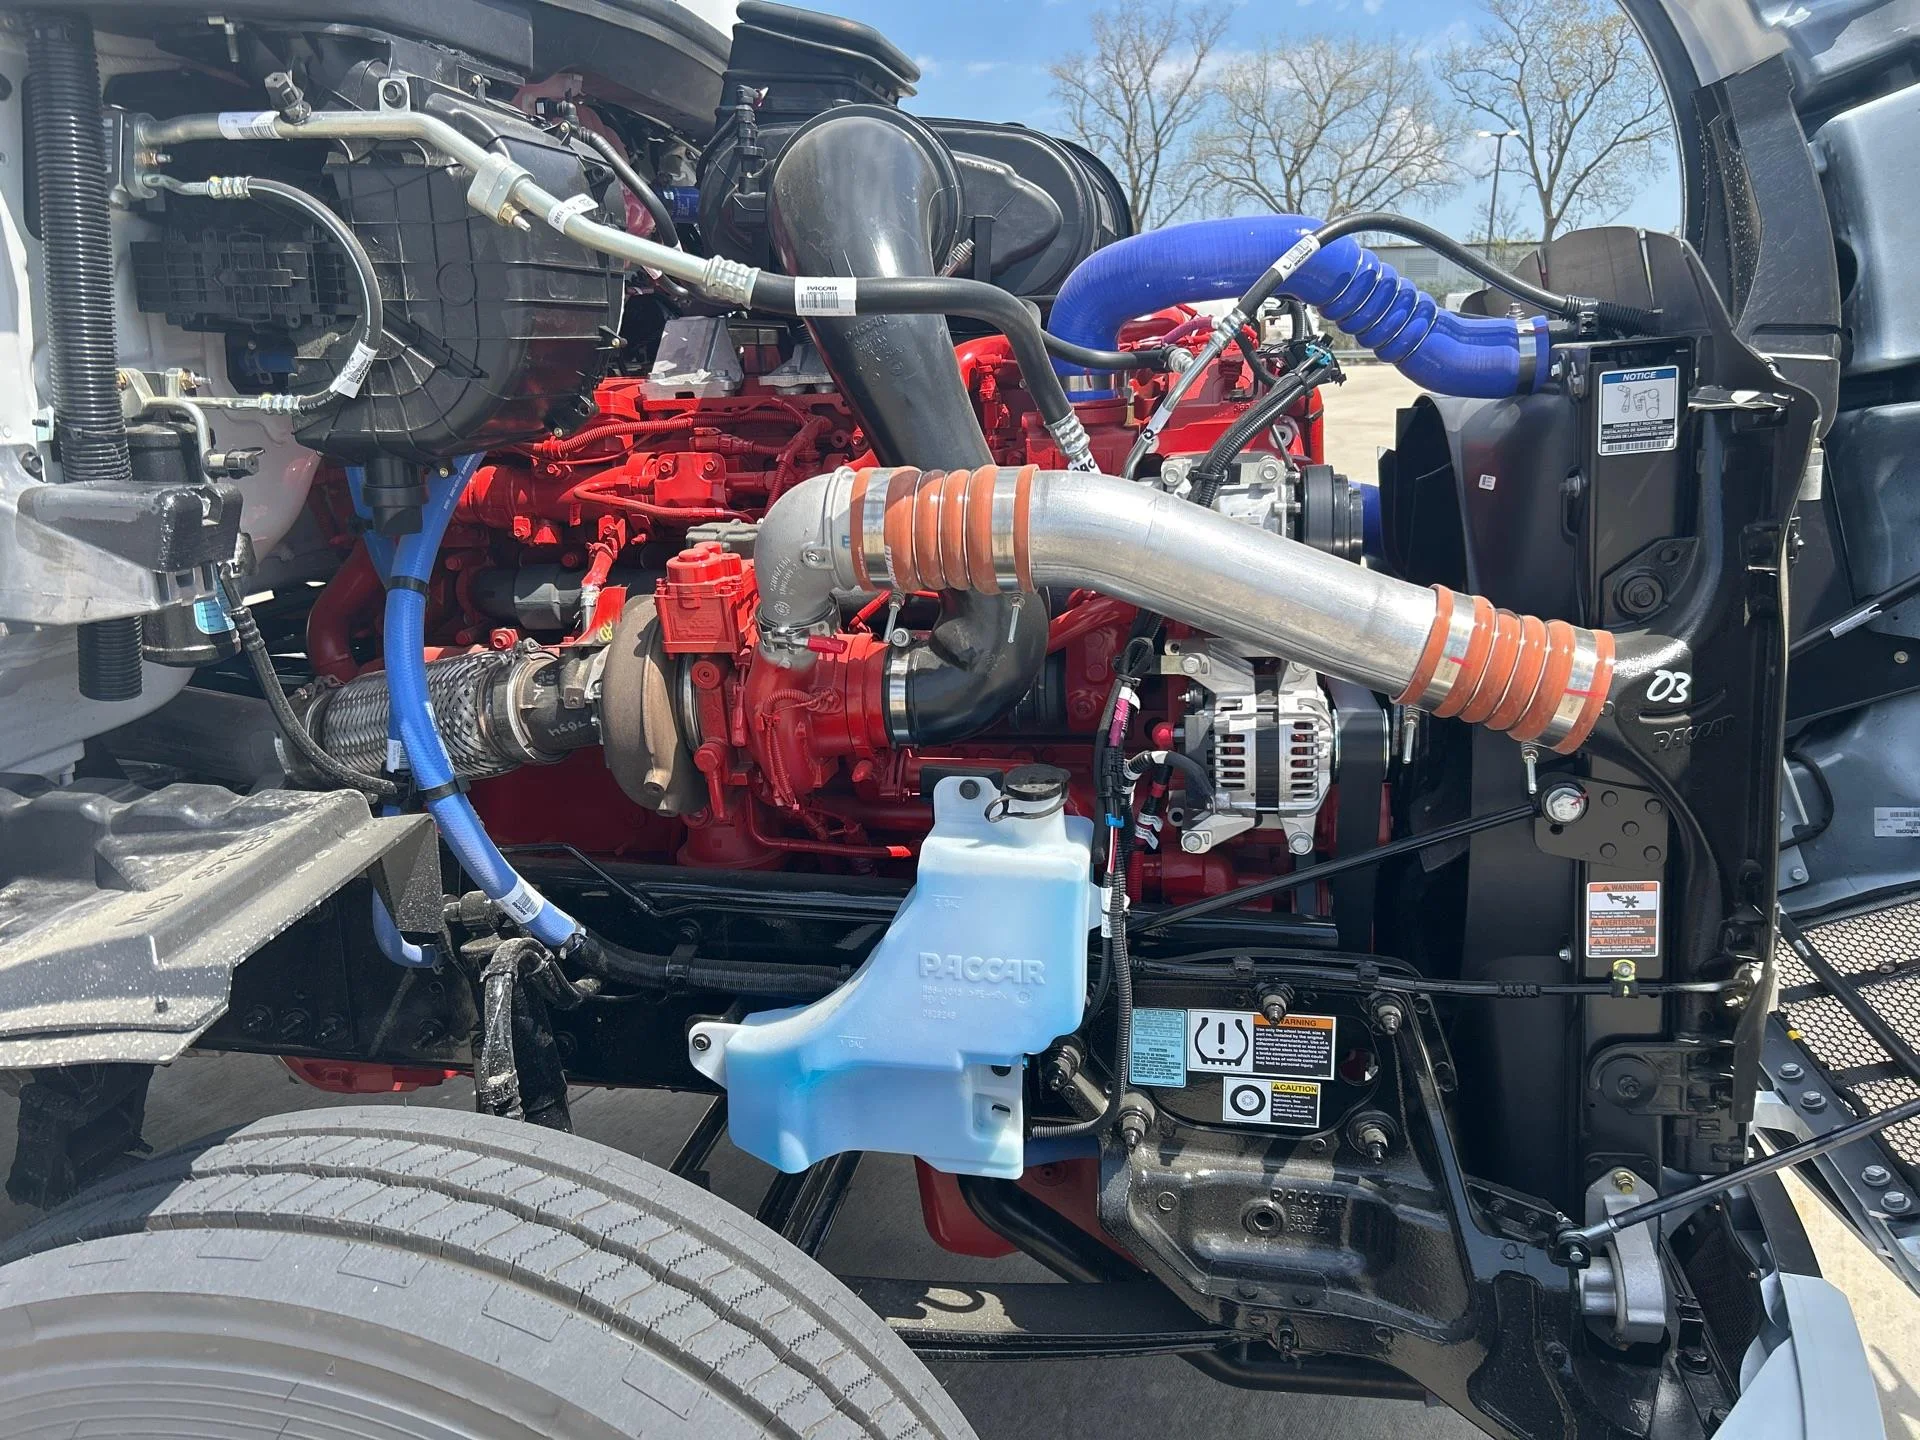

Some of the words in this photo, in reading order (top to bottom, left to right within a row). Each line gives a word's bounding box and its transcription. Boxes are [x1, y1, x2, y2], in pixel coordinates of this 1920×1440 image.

[1623, 372, 1656, 381] NOTICE
[1647, 670, 1691, 703] 03
[115, 894, 183, 927] NO
[919, 952, 1046, 985] PACCAR
[1280, 1084, 1317, 1093] CAUTION
[1270, 1187, 1347, 1203] PACCAR
